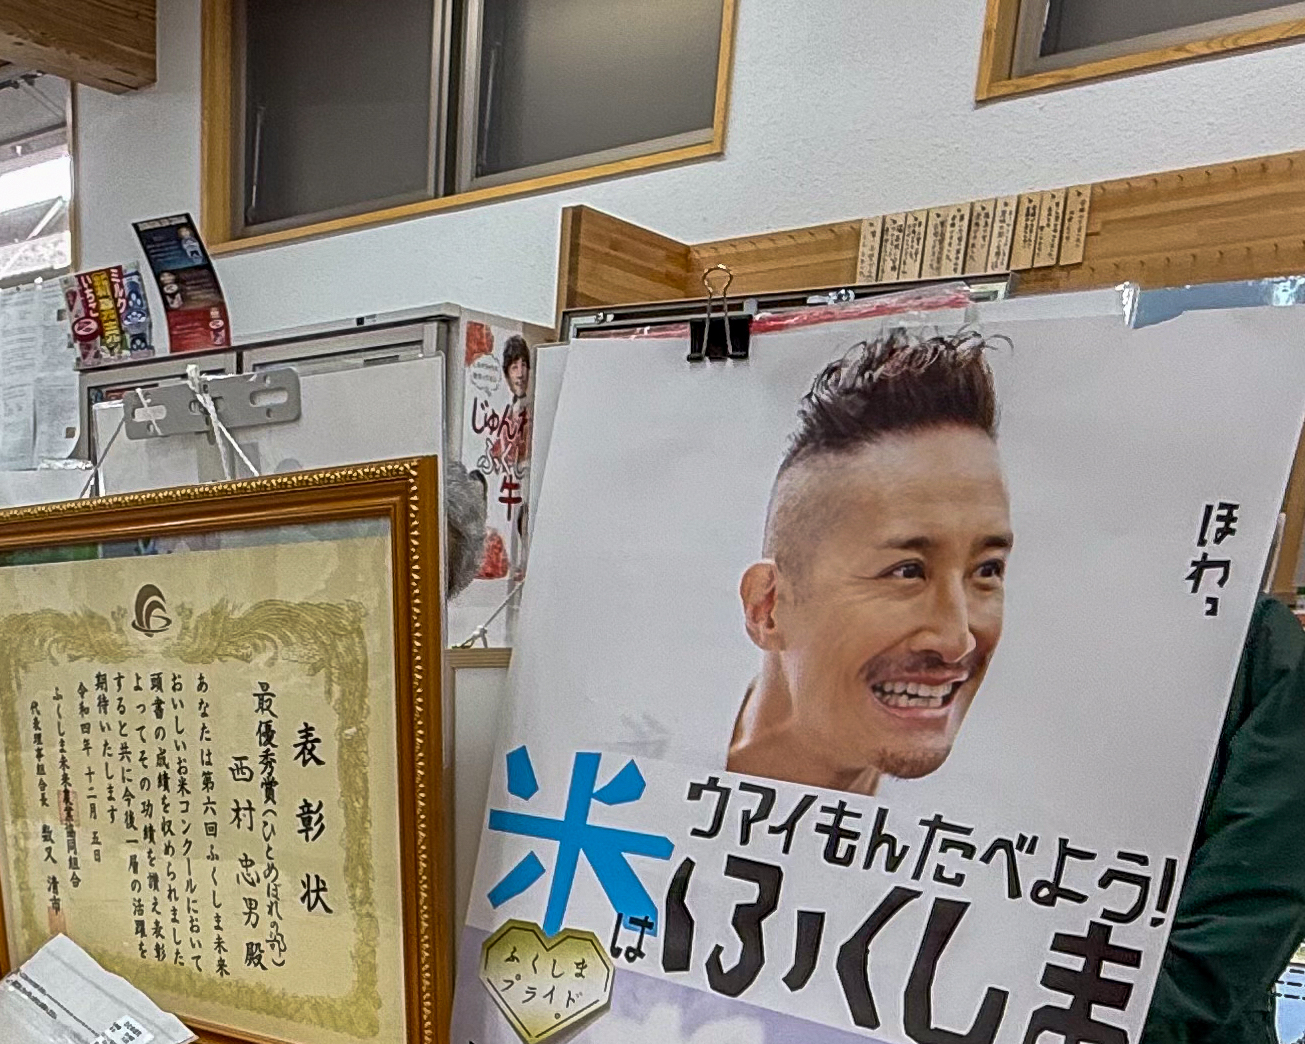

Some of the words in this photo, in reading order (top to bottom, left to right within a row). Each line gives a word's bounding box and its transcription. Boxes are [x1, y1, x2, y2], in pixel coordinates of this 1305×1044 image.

[1185, 502, 1240, 616] ほわっ
[95, 671, 118, 824] 期待いたします
[113, 671, 148, 959] すると共に今後一層の活躍を
[150, 671, 185, 967] 頭書の成績を収められました
[171, 672, 203, 972] おいしいお米コンクールにおいて
[196, 671, 231, 978] あなたは第六回ふくしま未来
[293, 721, 334, 914] 表彰状
[486, 744, 675, 938] 米
[609, 911, 655, 963] は
[504, 947, 589, 980] ふくしま
